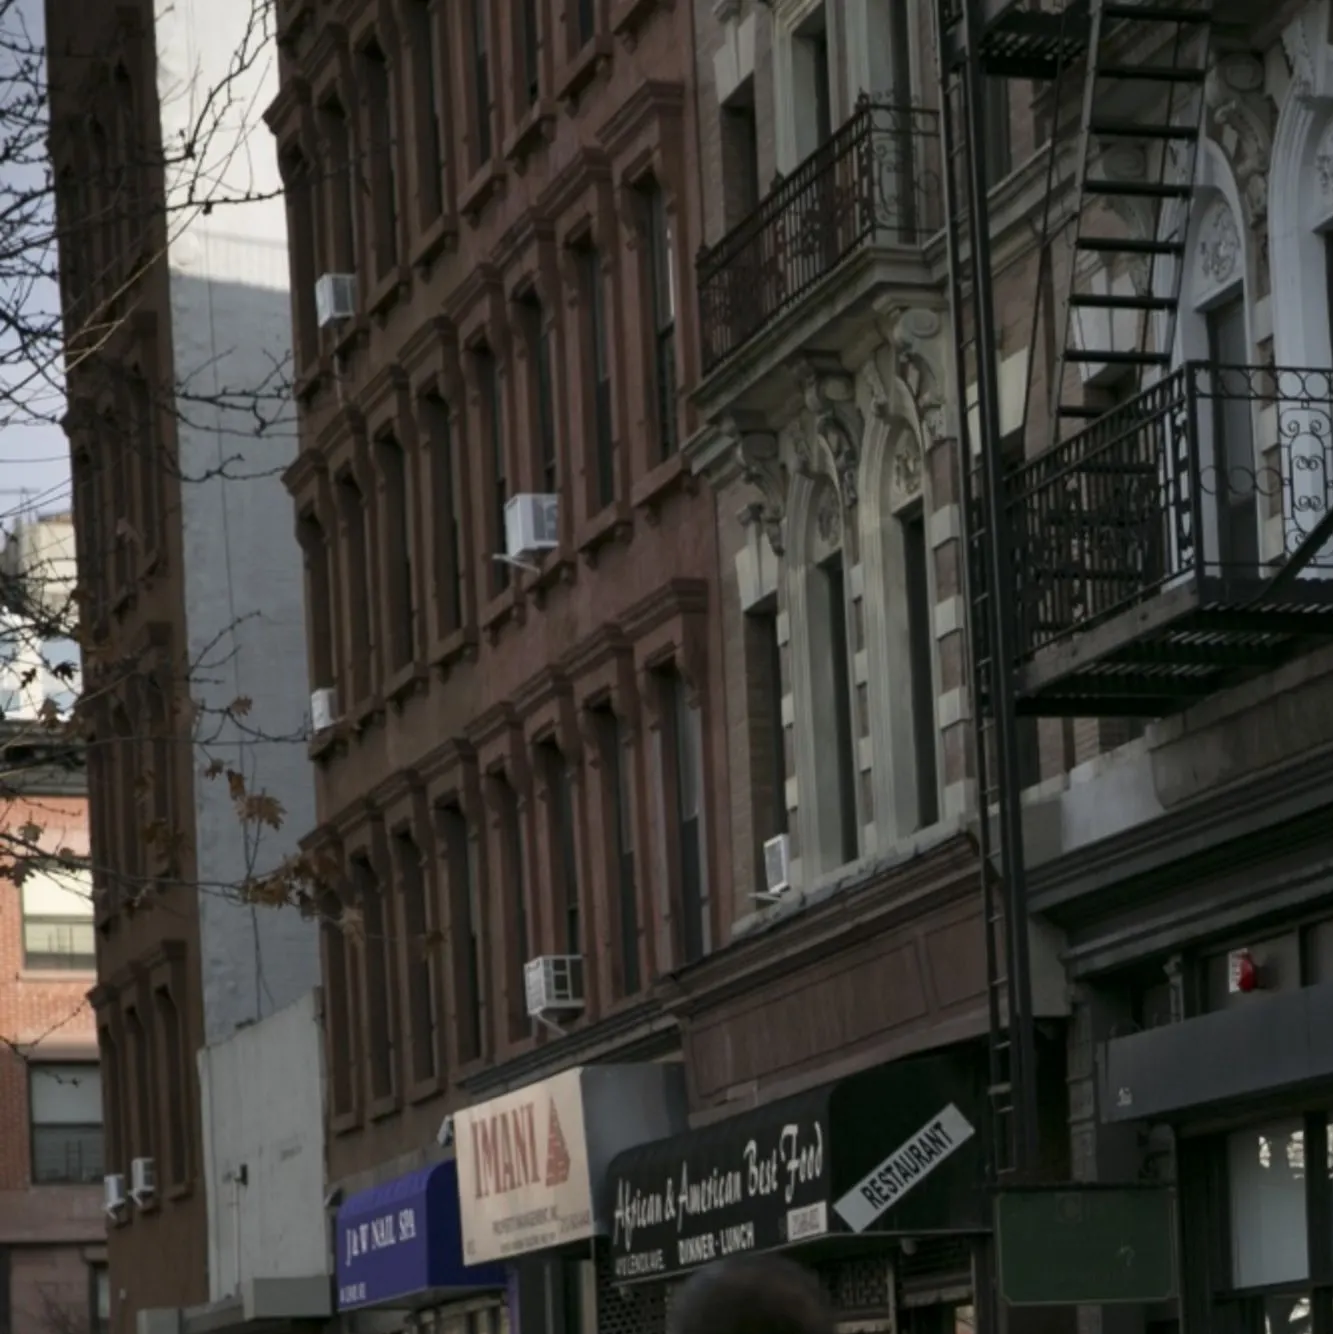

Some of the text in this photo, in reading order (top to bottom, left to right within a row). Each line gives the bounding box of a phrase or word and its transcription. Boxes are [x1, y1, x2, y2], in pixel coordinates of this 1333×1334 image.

[471, 1102, 541, 1198] IMANI
[613, 1177, 663, 1252] African
[664, 1177, 676, 1221] &
[676, 1160, 742, 1234] American
[743, 1138, 778, 1198] Best
[780, 1120, 824, 1203] Food
[859, 1121, 954, 1210] RESTAURANT
[370, 1213, 396, 1251] NAIL
[399, 1207, 416, 1242] SPA
[677, 1232, 716, 1265] DINNER
[720, 1222, 755, 1255] LUNCH
